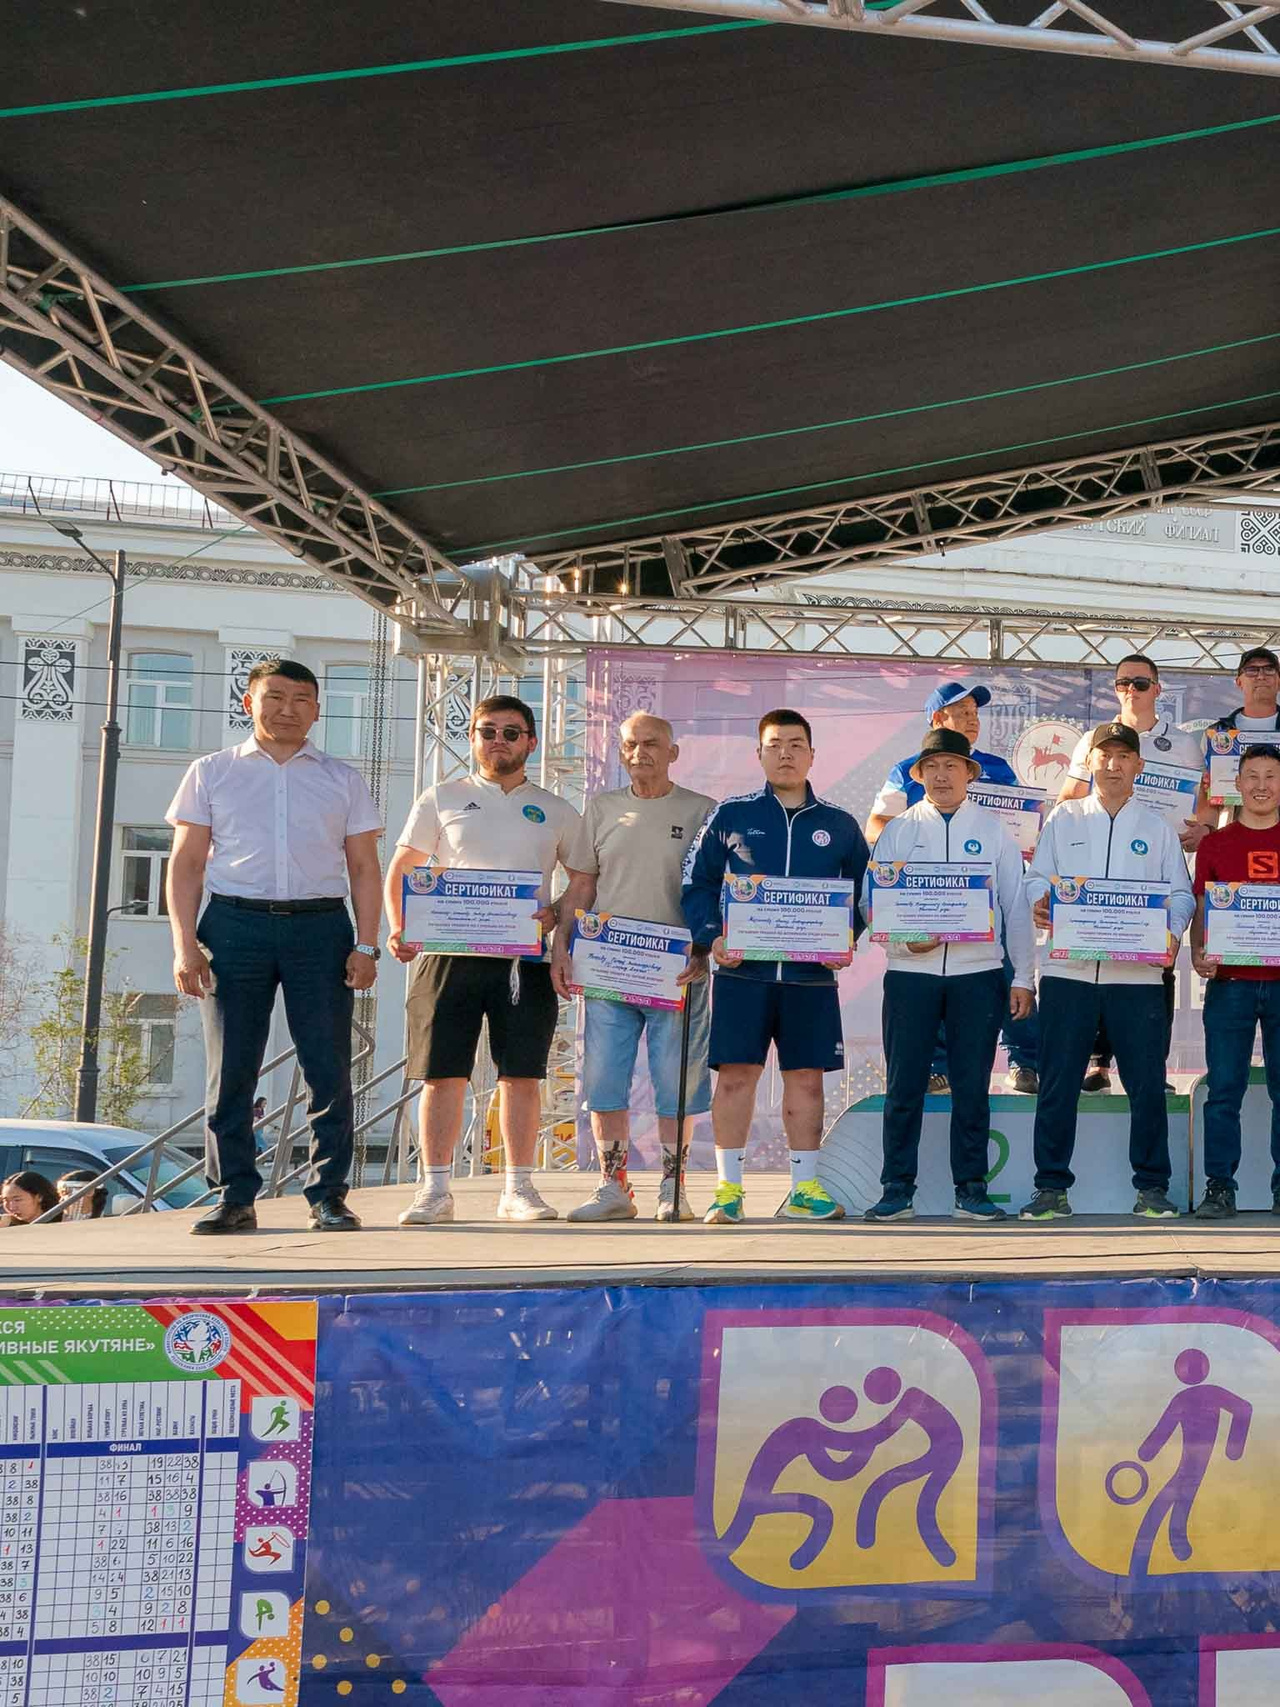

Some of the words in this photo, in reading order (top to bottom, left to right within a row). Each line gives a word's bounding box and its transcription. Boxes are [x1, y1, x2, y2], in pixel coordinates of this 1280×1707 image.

[1134, 773, 1180, 790] РТИФИКАТ
[966, 792, 1025, 810] СЕРТИФИКАТ
[445, 883, 518, 897] СЕРТИФИКАТ
[906, 876, 970, 888] СЕРТИФИКАТ
[764, 891, 831, 905] СЕРТИФИКАТ
[1087, 893, 1149, 906] СЕРТИФИКАТ
[607, 931, 671, 951] СЕРТИФИКАТ
[0, 1321, 25, 1334] СЯ
[64, 1338, 155, 1353] ЯКУТЯНЕ»
[109, 1443, 142, 1452] ФИНАЛ
[10, 1463, 17, 1474] 8
[100, 1460, 112, 1470] 38
[152, 1456, 163, 1468] 19
[167, 1456, 182, 1467] 22
[184, 1455, 199, 1468] 38
[8, 1480, 17, 1489] 2
[25, 1480, 38, 1489] 38
[100, 1476, 109, 1485] 11
[117, 1475, 126, 1485] 7
[148, 1474, 161, 1484] 15
[167, 1473, 179, 1482] 16
[186, 1473, 194, 1484] 4
[6, 1496, 18, 1506] 38
[27, 1495, 33, 1505] 8
[115, 1491, 127, 1500] 16
[148, 1490, 161, 1501] 38
[166, 1489, 179, 1500] 38
[181, 1488, 196, 1500] 38
[5, 1513, 17, 1522] 38
[24, 1513, 31, 1521] 2
[99, 1509, 105, 1517] 4
[185, 1504, 192, 1516] 9
[4, 1528, 15, 1537] 10
[22, 1527, 32, 1537] 11
[98, 1525, 106, 1534] 7
[145, 1522, 160, 1534] 38
[165, 1521, 177, 1532] 13
[183, 1520, 191, 1530] 2
[21, 1544, 33, 1554] 13
[111, 1539, 126, 1549] 22
[147, 1538, 158, 1549] 11
[166, 1538, 173, 1548] 6
[180, 1537, 193, 1548] 16
[1, 1561, 13, 1570] 38
[22, 1561, 30, 1570] 7
[94, 1556, 107, 1568] 38
[148, 1554, 158, 1565] 5
[163, 1554, 175, 1563] 10
[179, 1552, 193, 1563] 22
[0, 1578, 13, 1587] 38
[93, 1573, 105, 1582] 14
[144, 1570, 159, 1582] 38
[162, 1570, 174, 1579] 21
[178, 1569, 192, 1580] 13
[19, 1593, 27, 1601] 6
[95, 1589, 101, 1600] 9
[111, 1588, 120, 1599] 5
[144, 1587, 153, 1598] 2
[161, 1586, 172, 1596] 15
[178, 1585, 191, 1596] 10
[15, 1610, 28, 1619] 38
[109, 1605, 117, 1616] 4
[145, 1602, 152, 1614] 9
[161, 1602, 170, 1612] 2
[178, 1601, 187, 1613] 8
[17, 1627, 24, 1637] 4
[92, 1622, 99, 1633] 5
[109, 1621, 116, 1632] 8
[141, 1619, 154, 1631] 12
[162, 1619, 166, 1628] 1
[179, 1617, 185, 1628] 1
[13, 1659, 23, 1668] 10
[86, 1655, 99, 1667] 38
[104, 1653, 116, 1665] 15
[158, 1650, 167, 1663] 7
[173, 1649, 186, 1662] 21
[10, 1676, 23, 1686] 38
[86, 1672, 98, 1682] 10
[104, 1672, 116, 1681] 10
[136, 1669, 150, 1680] 10
[175, 1667, 185, 1678] 5
[12, 1693, 20, 1704] 5
[83, 1688, 97, 1700] 38
[105, 1687, 112, 1698] 2
[137, 1686, 148, 1698] 7
[156, 1685, 162, 1695] 4
[169, 1683, 186, 1695] 15
